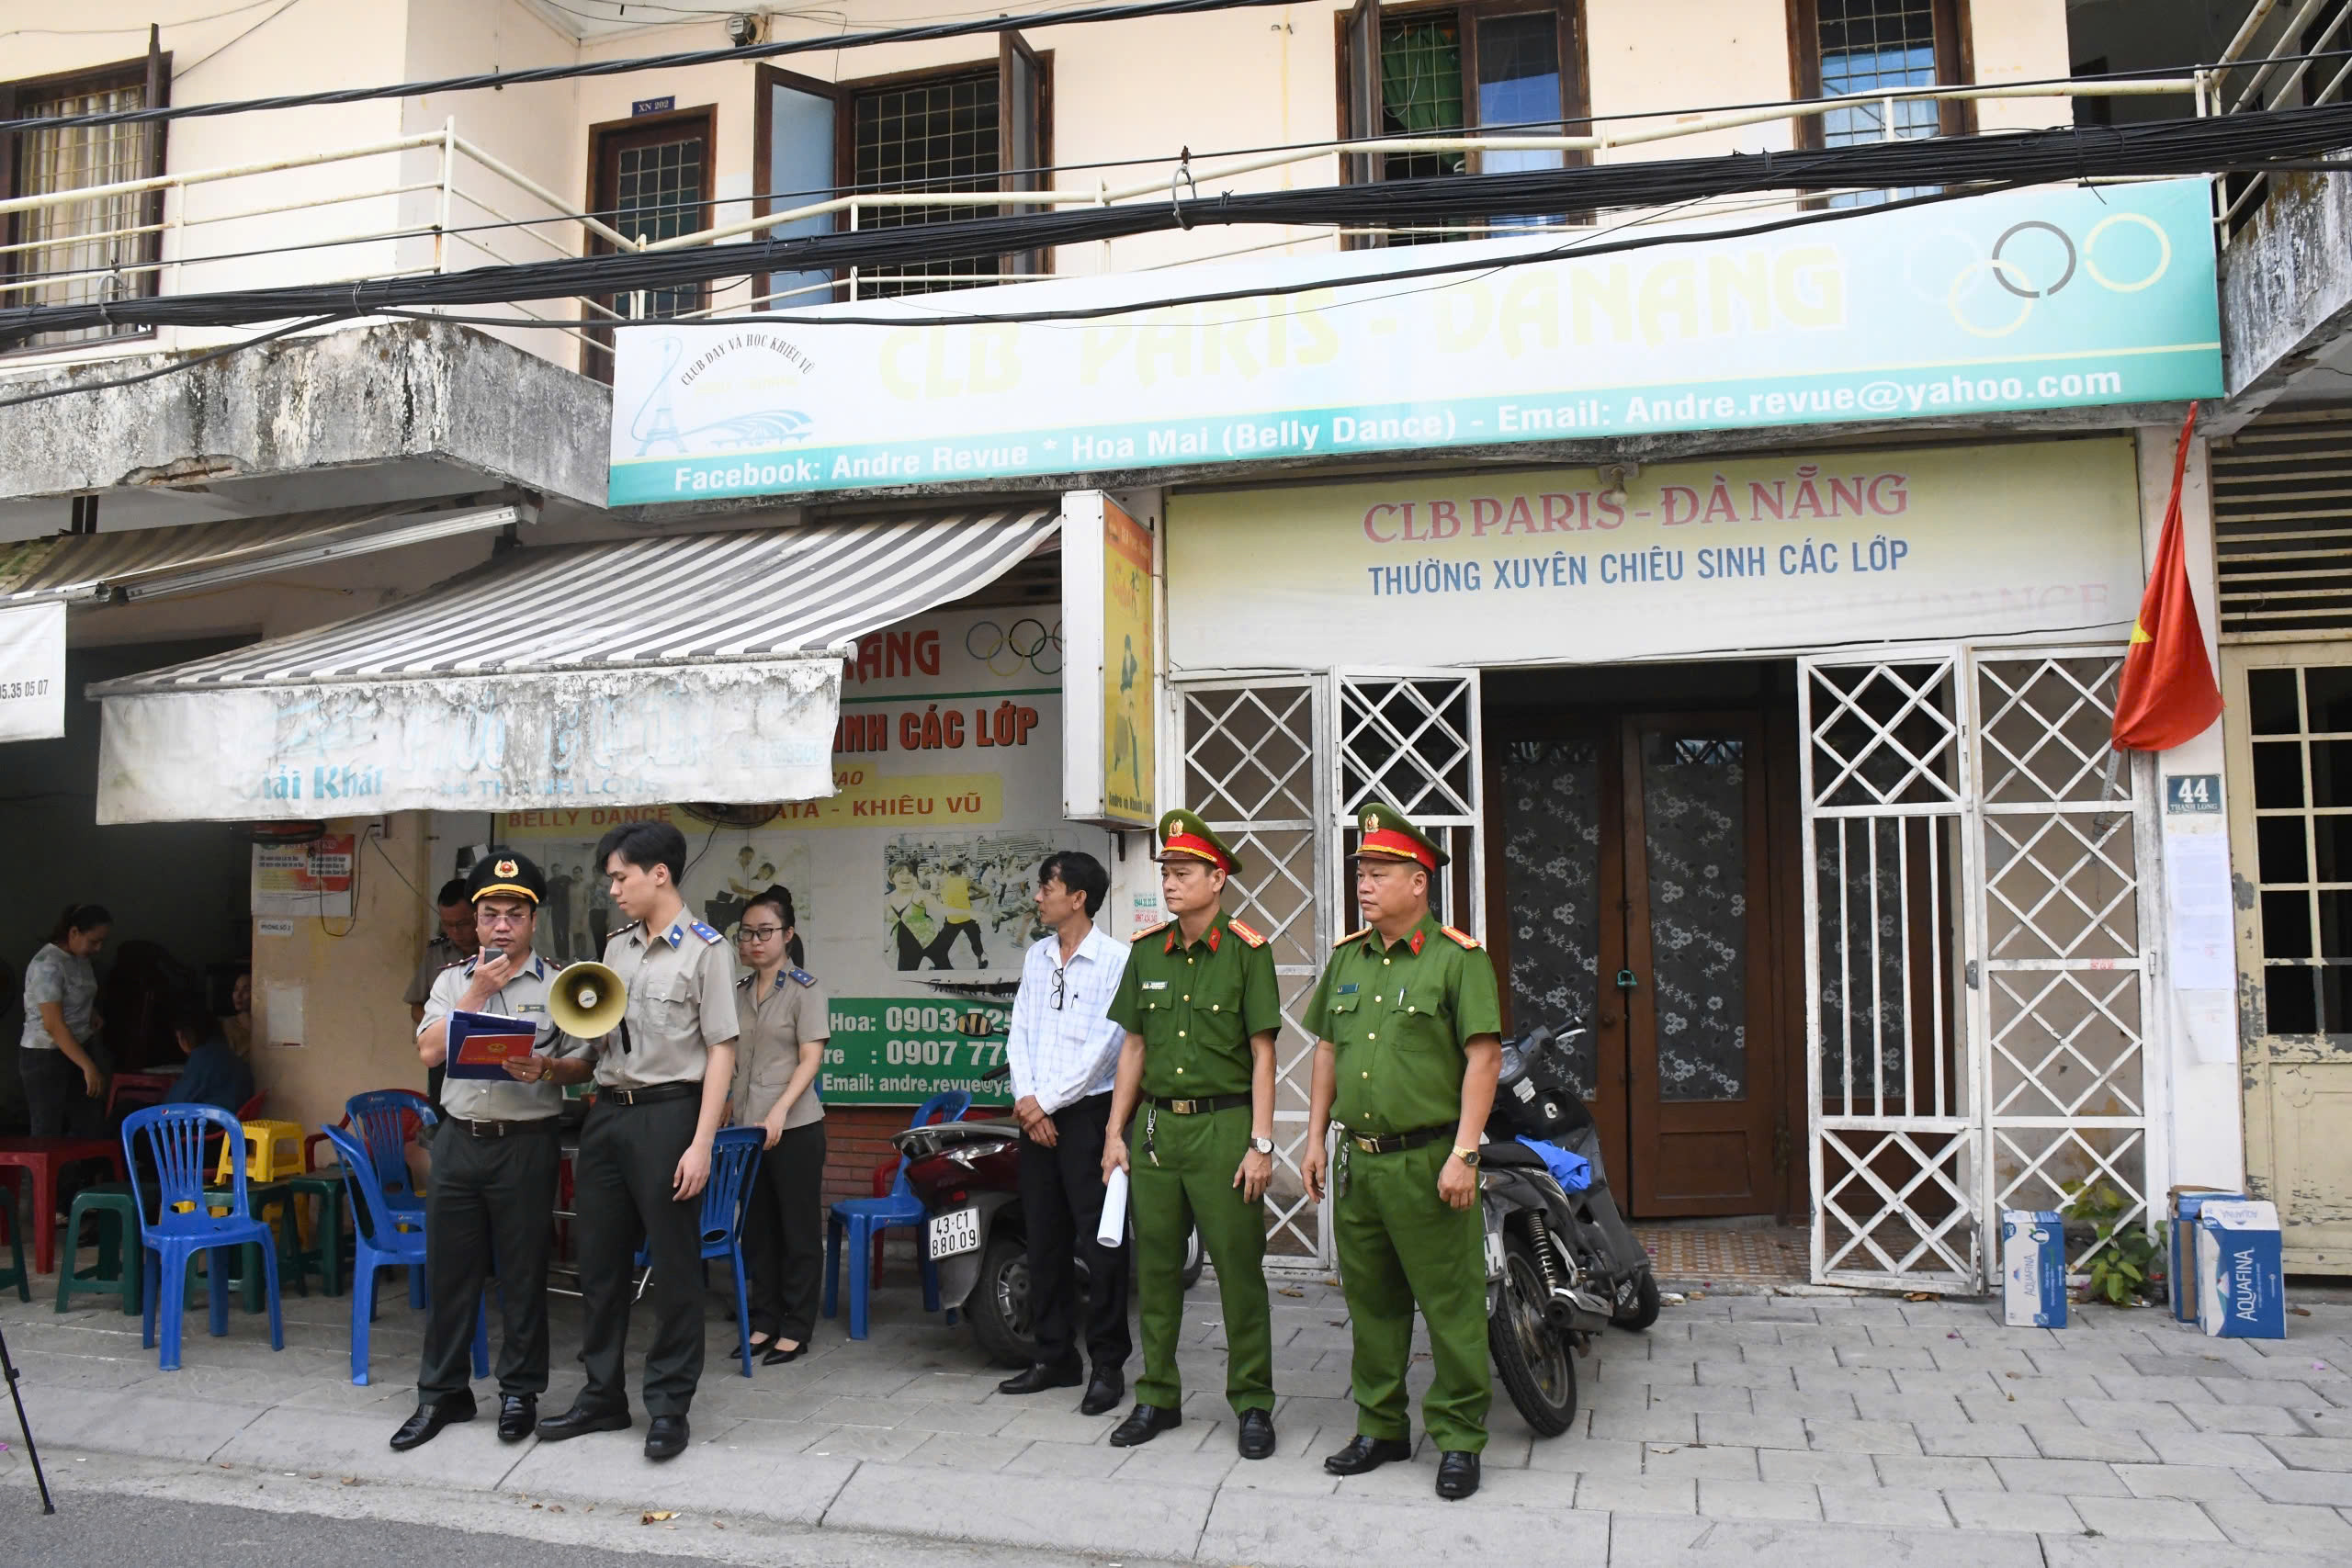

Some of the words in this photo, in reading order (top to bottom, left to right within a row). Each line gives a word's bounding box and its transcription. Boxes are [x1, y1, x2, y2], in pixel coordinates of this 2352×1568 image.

[681, 359, 706, 386] CLUB
[674, 457, 820, 492] Facebook:
[831, 451, 921, 480] Andre
[932, 446, 1029, 472] Revue
[1071, 434, 1135, 461] Hoa
[1148, 426, 1208, 457] Mai
[1222, 419, 1321, 456] (Belly
[1332, 410, 1457, 445] Dance)
[1498, 399, 1611, 433] Email:
[1624, 370, 2122, 424] Andre.revue@yahoo.com
[1363, 501, 1462, 544] CLB
[1469, 488, 1626, 537] PARIS
[1659, 473, 1741, 526] ĐÀ
[1748, 465, 1908, 522] NẴNG
[1367, 558, 1481, 596] THƯỜNG
[1493, 550, 1588, 590] XUYÊN
[1600, 545, 1684, 584] CHIÊU
[1697, 546, 1766, 580] SINH
[1779, 537, 1838, 576] CÁC
[1851, 534, 1909, 572] LỚP
[0, 682, 22, 700] 5.35
[833, 713, 888, 753] INH
[899, 703, 965, 750] CÁC
[976, 700, 1039, 747] LỚP
[832, 770, 864, 786] AO
[2177, 778, 2210, 803] 44
[508, 810, 580, 828] BELLY
[591, 807, 673, 825] DANCE
[853, 794, 934, 816] KHIÊU
[946, 792, 981, 814] VŨ
[2169, 803, 2196, 811] THANH
[831, 1013, 876, 1032] Hoa:
[885, 1006, 956, 1032] 0903
[886, 1040, 957, 1066] 0907
[967, 1041, 1009, 1066] 77
[822, 1073, 874, 1091] Email:
[878, 1073, 1012, 1098] andre.revue@ya
[936, 1212, 969, 1235] 43-C1
[932, 1229, 977, 1257] 880.09
[2024, 1252, 2037, 1297] AQUAFINA
[2233, 1247, 2258, 1322] AQUAFINA
